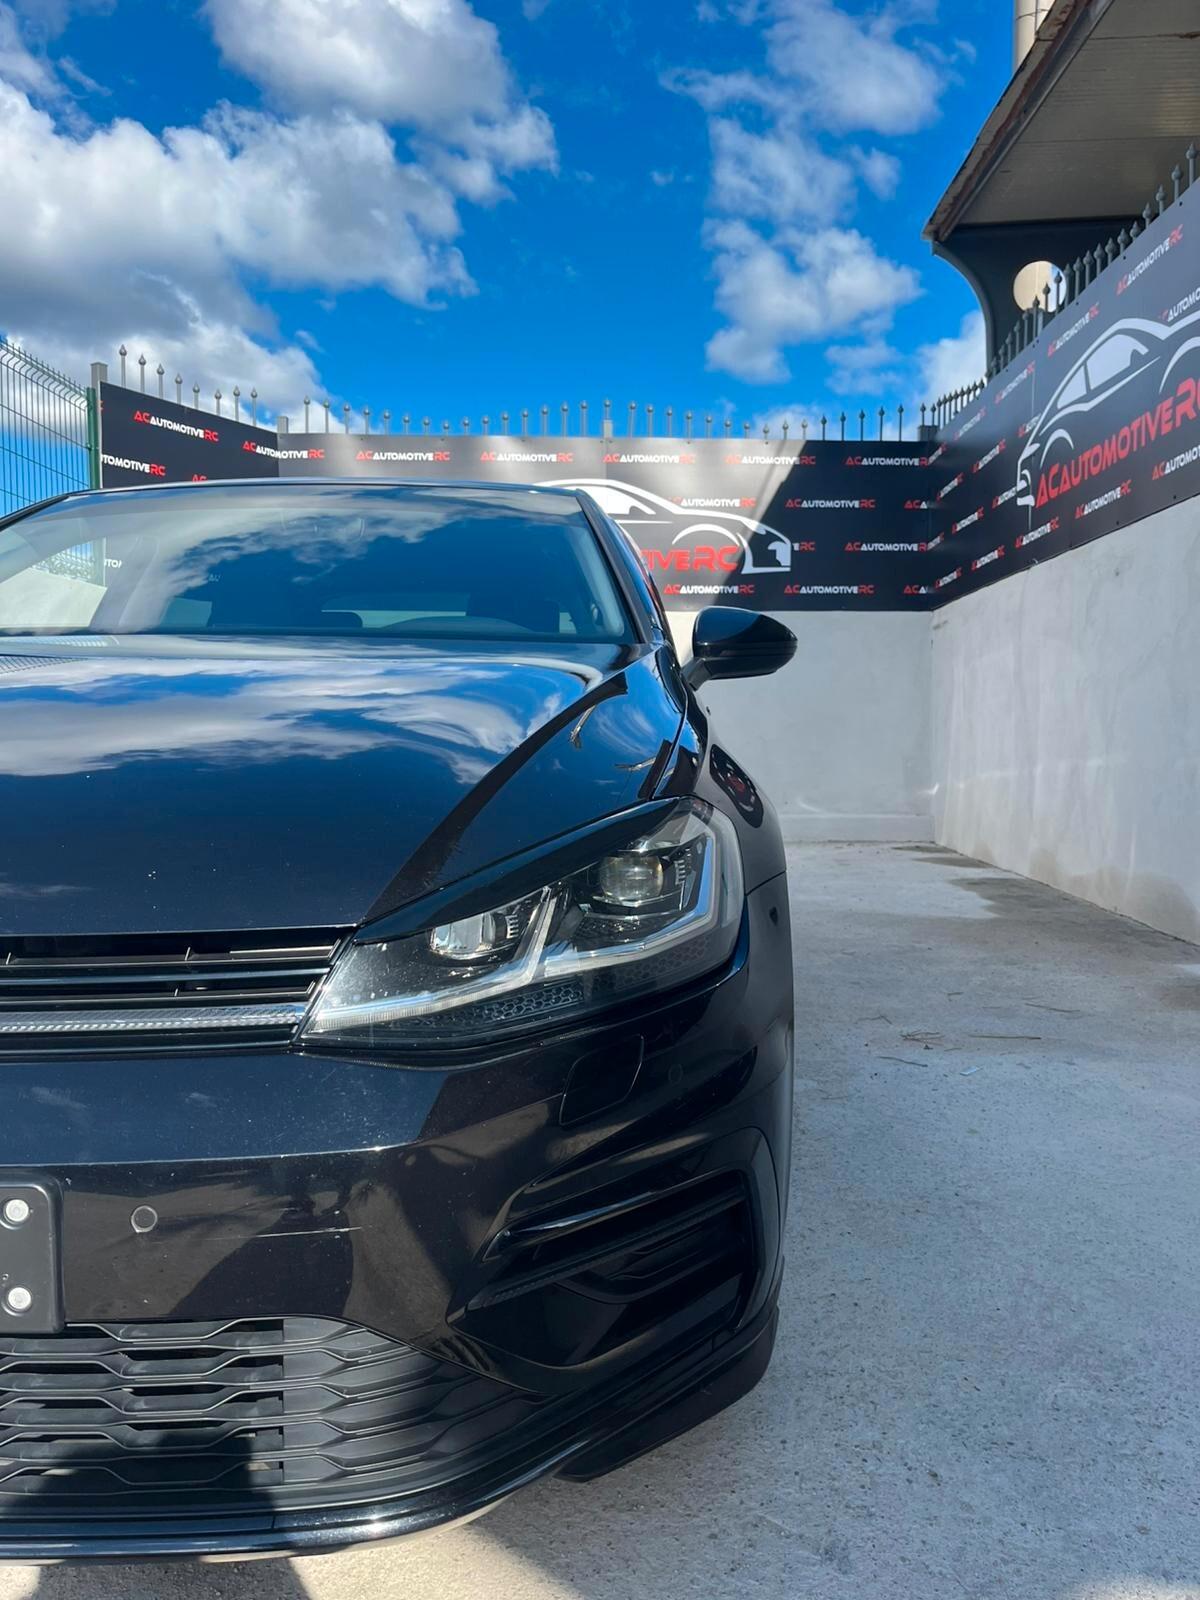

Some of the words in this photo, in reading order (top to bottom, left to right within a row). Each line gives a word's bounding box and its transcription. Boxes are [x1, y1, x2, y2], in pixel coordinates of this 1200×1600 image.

[133, 410, 220, 442] ACAUTOMOTIVERC
[242, 440, 325, 459] ACAUTOMOTIVERC
[355, 450, 450, 462] ACAUTOMOTIVERC
[480, 451, 574, 463] ACAUTOMOTIVERC
[603, 453, 696, 464] ACAUTOMOTIVERC
[725, 454, 817, 465] ACAUTOMOTIVERC
[785, 499, 876, 509] ACAUTOMOTIVERC
[664, 583, 756, 595] ACAUTOMOTIVERC
[784, 584, 875, 594] ACAUTOMOTIVERC
